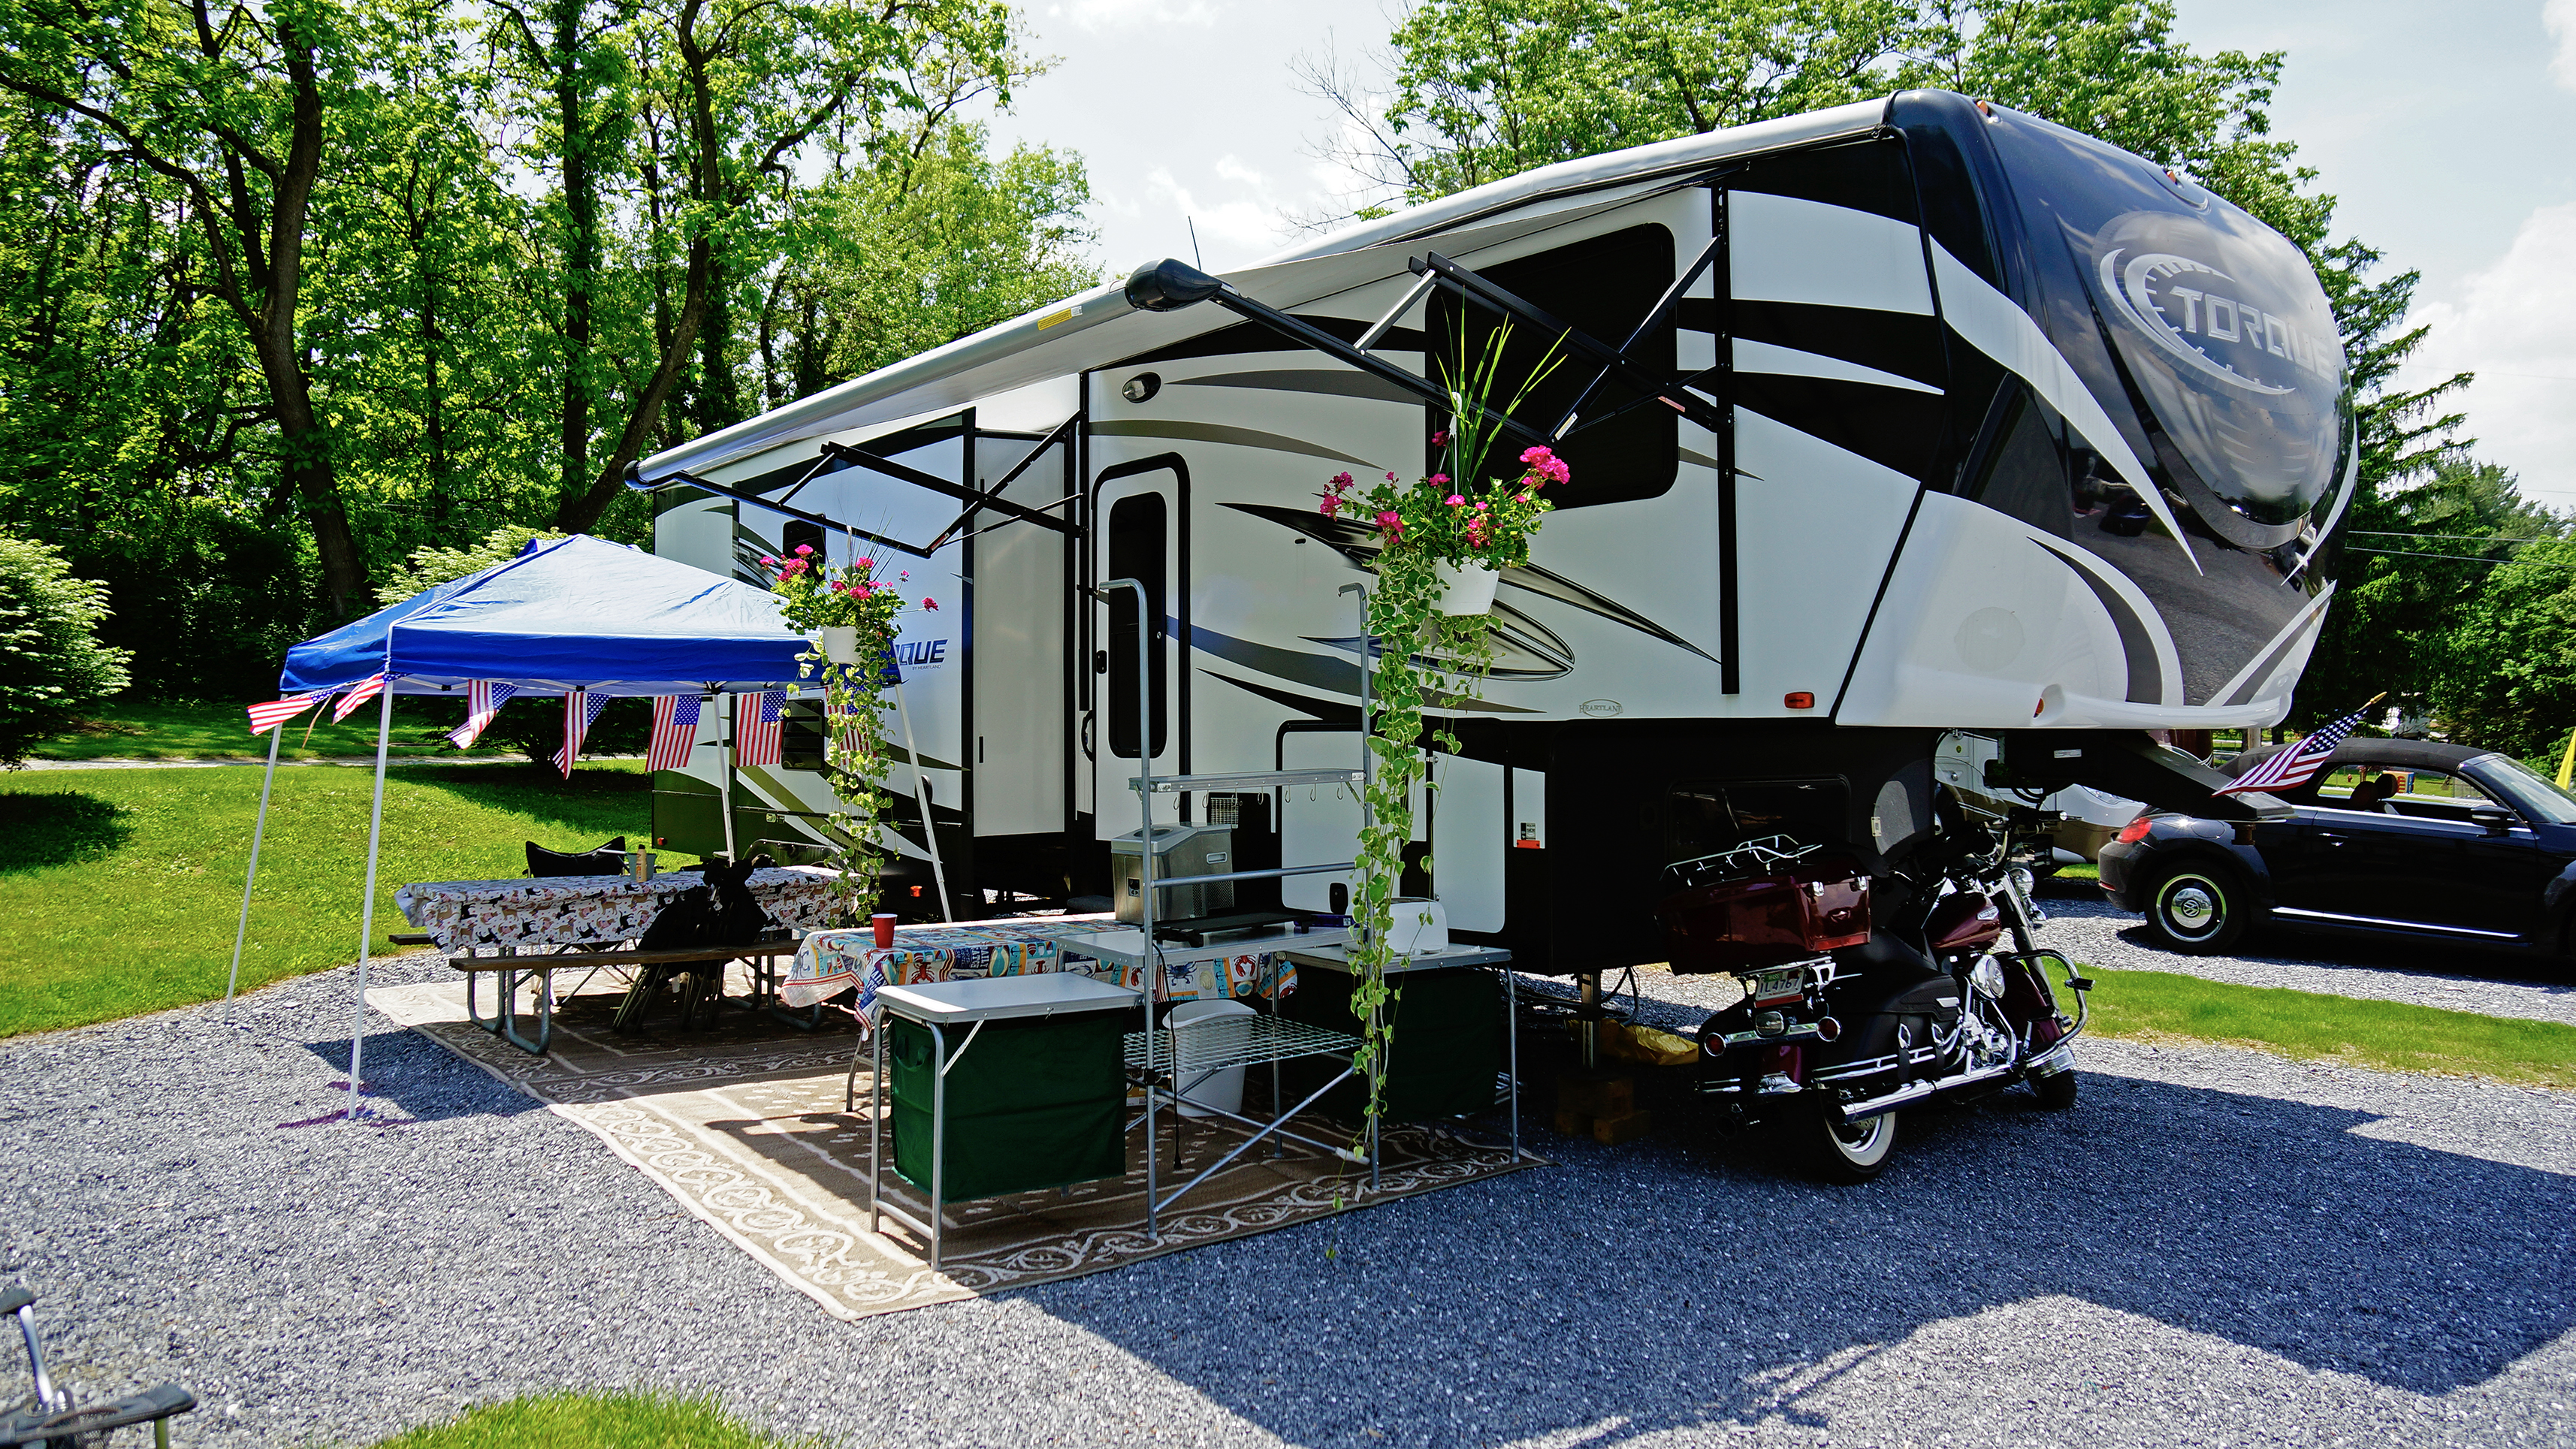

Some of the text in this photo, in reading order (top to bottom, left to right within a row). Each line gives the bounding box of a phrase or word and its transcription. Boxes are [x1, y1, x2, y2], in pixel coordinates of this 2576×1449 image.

[2170, 285, 2333, 383] TORQUE
[1579, 705, 1623, 714] HEARTLAND
[1760, 977, 1800, 993] 1L4767
